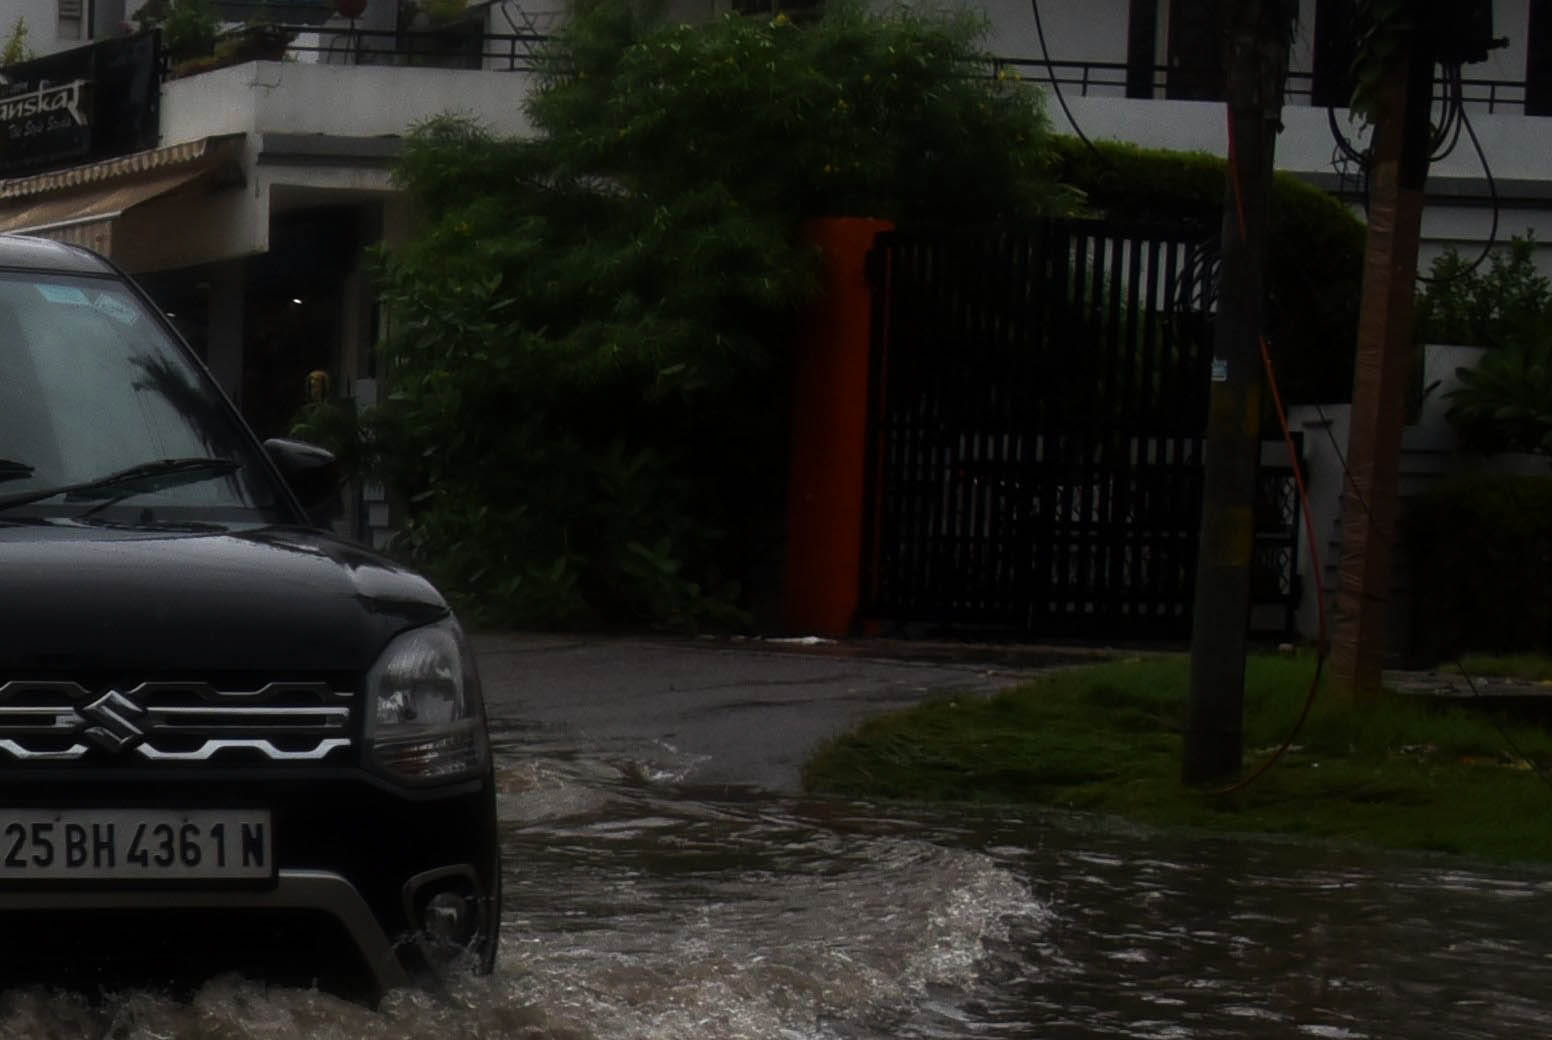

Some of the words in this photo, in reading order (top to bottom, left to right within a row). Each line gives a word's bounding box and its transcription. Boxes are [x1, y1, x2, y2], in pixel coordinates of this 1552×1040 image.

[5, 823, 54, 868] 25
[65, 823, 115, 868] BH
[127, 823, 225, 868] 4361
[242, 823, 264, 868] N
